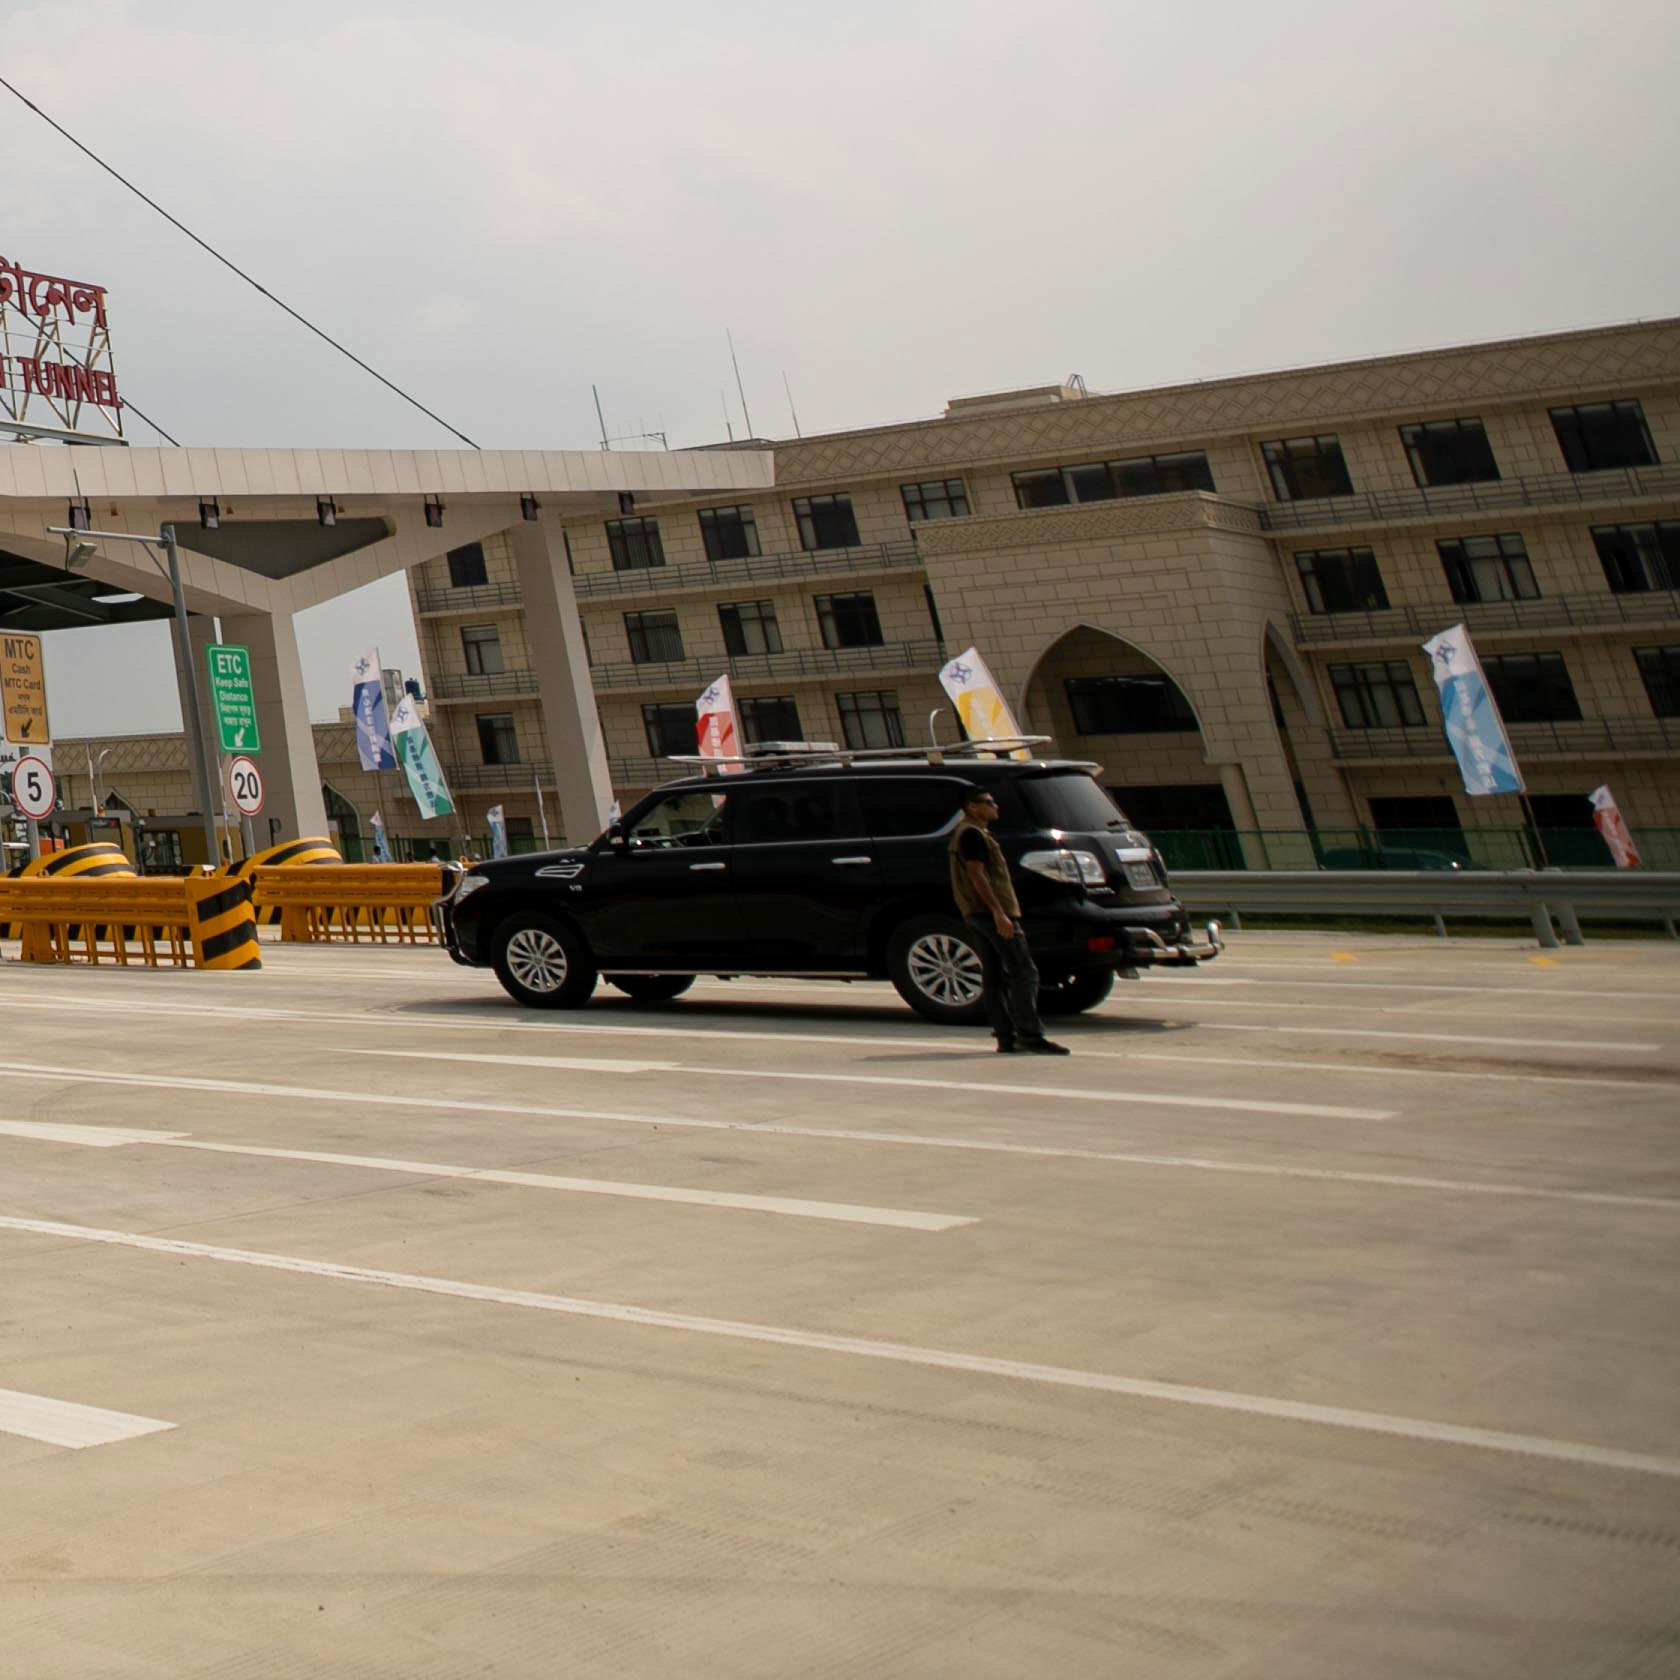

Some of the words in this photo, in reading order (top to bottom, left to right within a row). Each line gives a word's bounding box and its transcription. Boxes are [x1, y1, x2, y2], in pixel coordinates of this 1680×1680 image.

[17, 356, 124, 409] TUNNEL
[4, 639, 34, 660] MTC
[12, 663, 31, 674] Cash
[217, 654, 242, 674] ETC
[4, 678, 21, 688] MTC
[24, 679, 41, 690] Card
[215, 677, 232, 690] Keep
[233, 678, 249, 690] Safe
[219, 692, 248, 703] Distance
[28, 772, 41, 802] 5
[234, 771, 259, 800] 20
